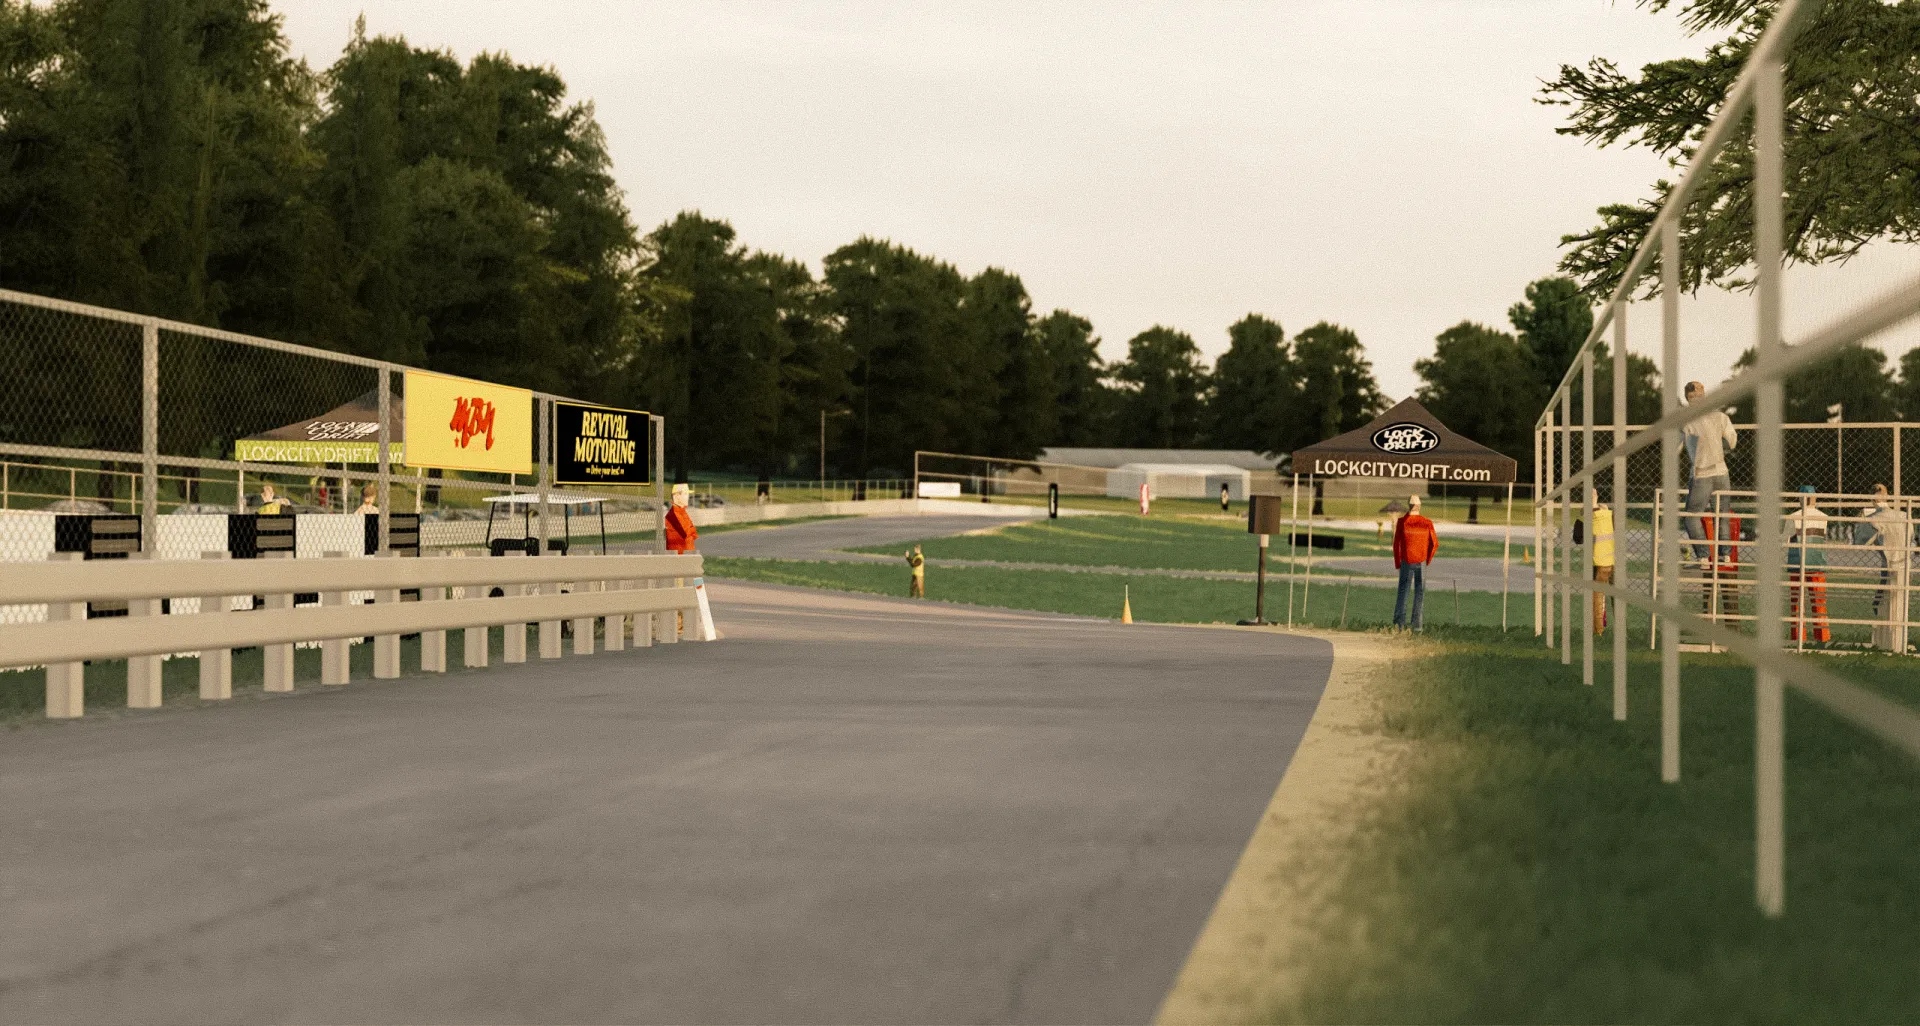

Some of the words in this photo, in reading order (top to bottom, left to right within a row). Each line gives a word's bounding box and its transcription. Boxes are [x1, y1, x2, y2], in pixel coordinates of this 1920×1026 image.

[581, 410, 629, 439] REVIVAL
[1383, 428, 1425, 438] LOCK
[242, 445, 404, 463] LOCKCITYDRIFT.m
[573, 437, 636, 465] MOTORING
[1315, 459, 1491, 481] LOCKCITYDRIFT.com
